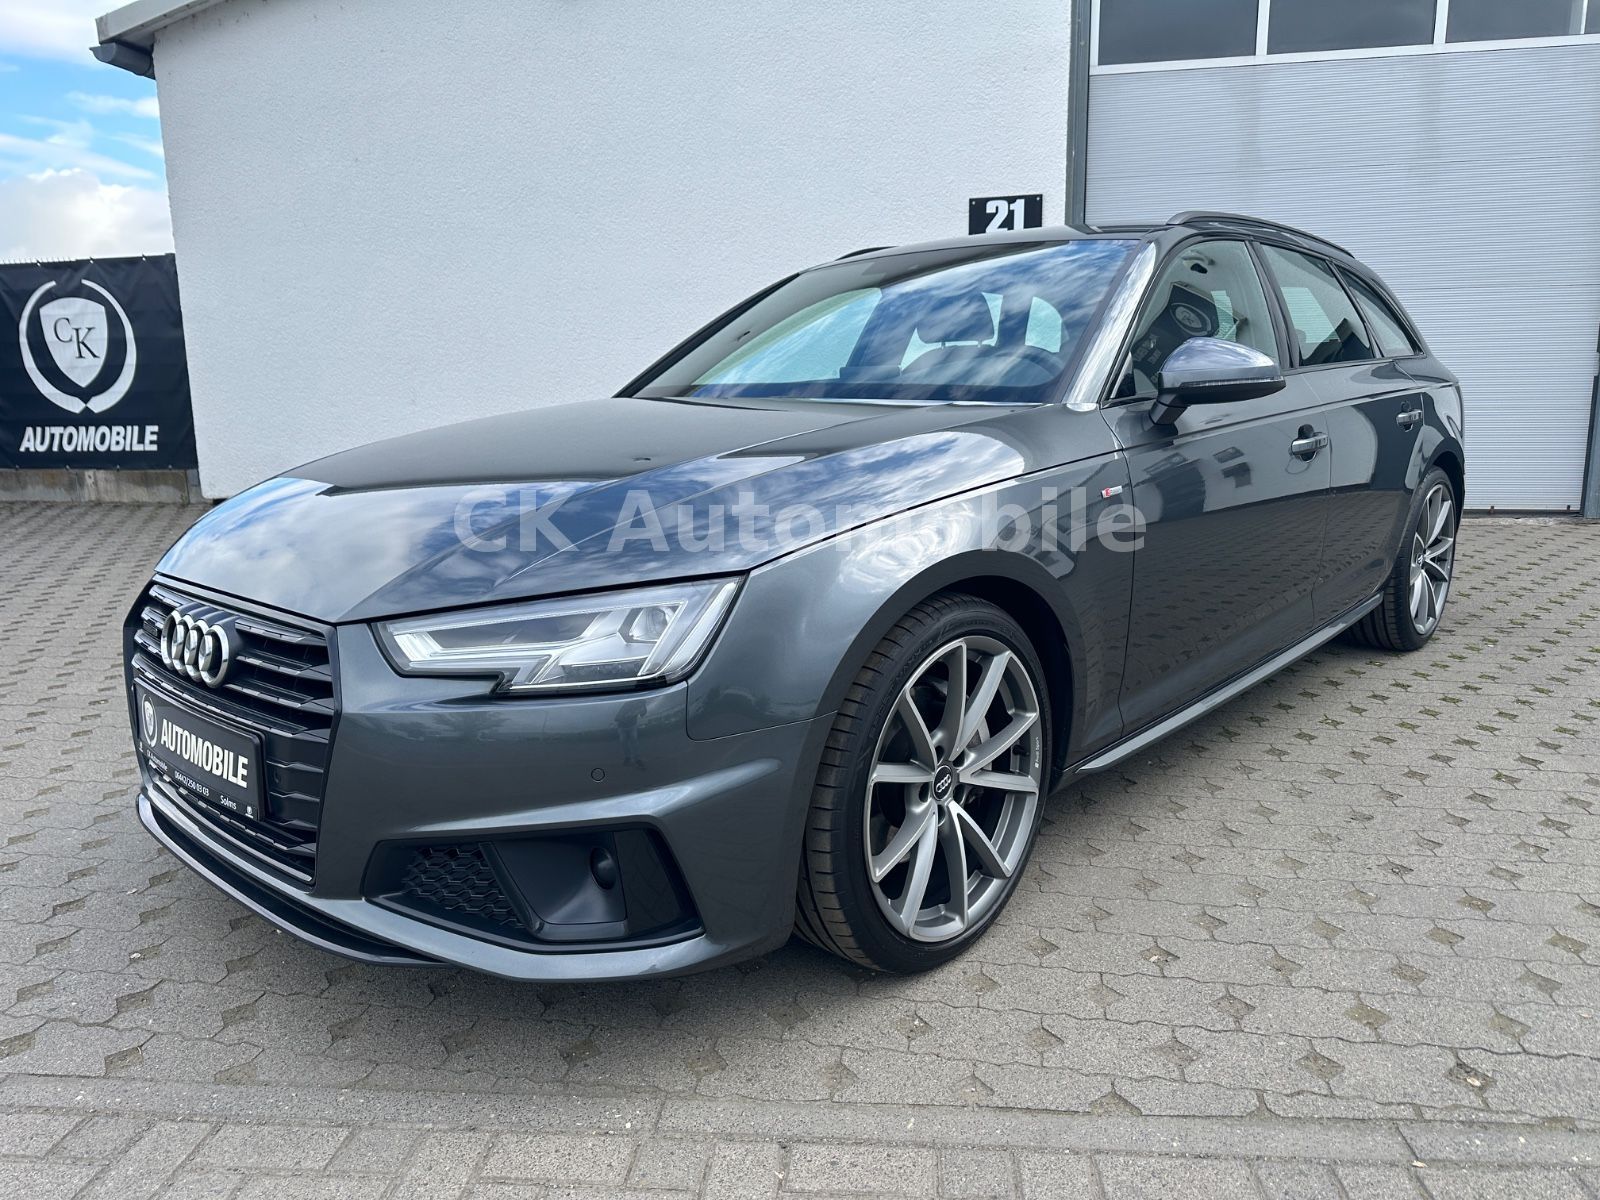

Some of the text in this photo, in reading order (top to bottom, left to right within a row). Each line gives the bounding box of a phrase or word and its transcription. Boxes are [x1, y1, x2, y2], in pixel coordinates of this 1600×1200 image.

[985, 198, 1025, 234] 21
[53, 317, 100, 359] CK
[19, 425, 159, 452] AUTOMOBILE
[161, 718, 249, 789] AUTOMOBILE
